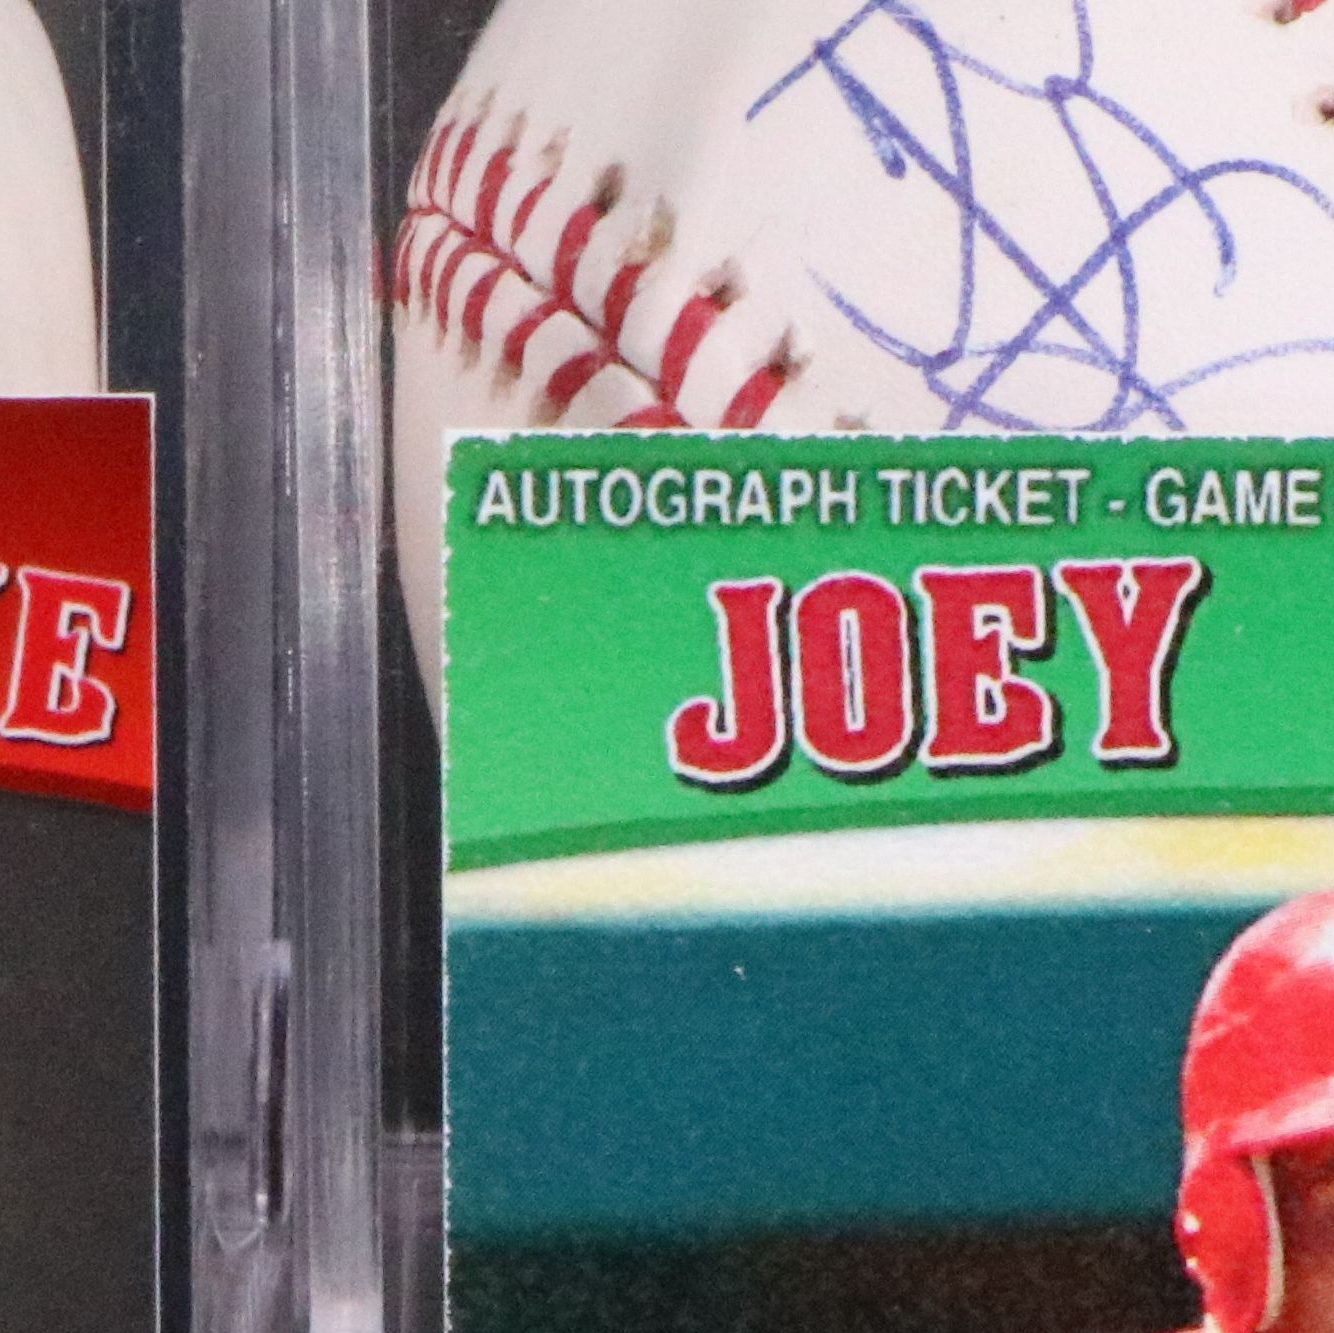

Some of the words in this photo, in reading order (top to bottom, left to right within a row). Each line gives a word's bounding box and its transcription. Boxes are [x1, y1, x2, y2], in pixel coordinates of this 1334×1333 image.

[477, 467, 859, 526] AUTOGRAPH
[878, 468, 1087, 526] TICKET
[1145, 467, 1323, 527] GAME
[665, 557, 1207, 786] JOEY
